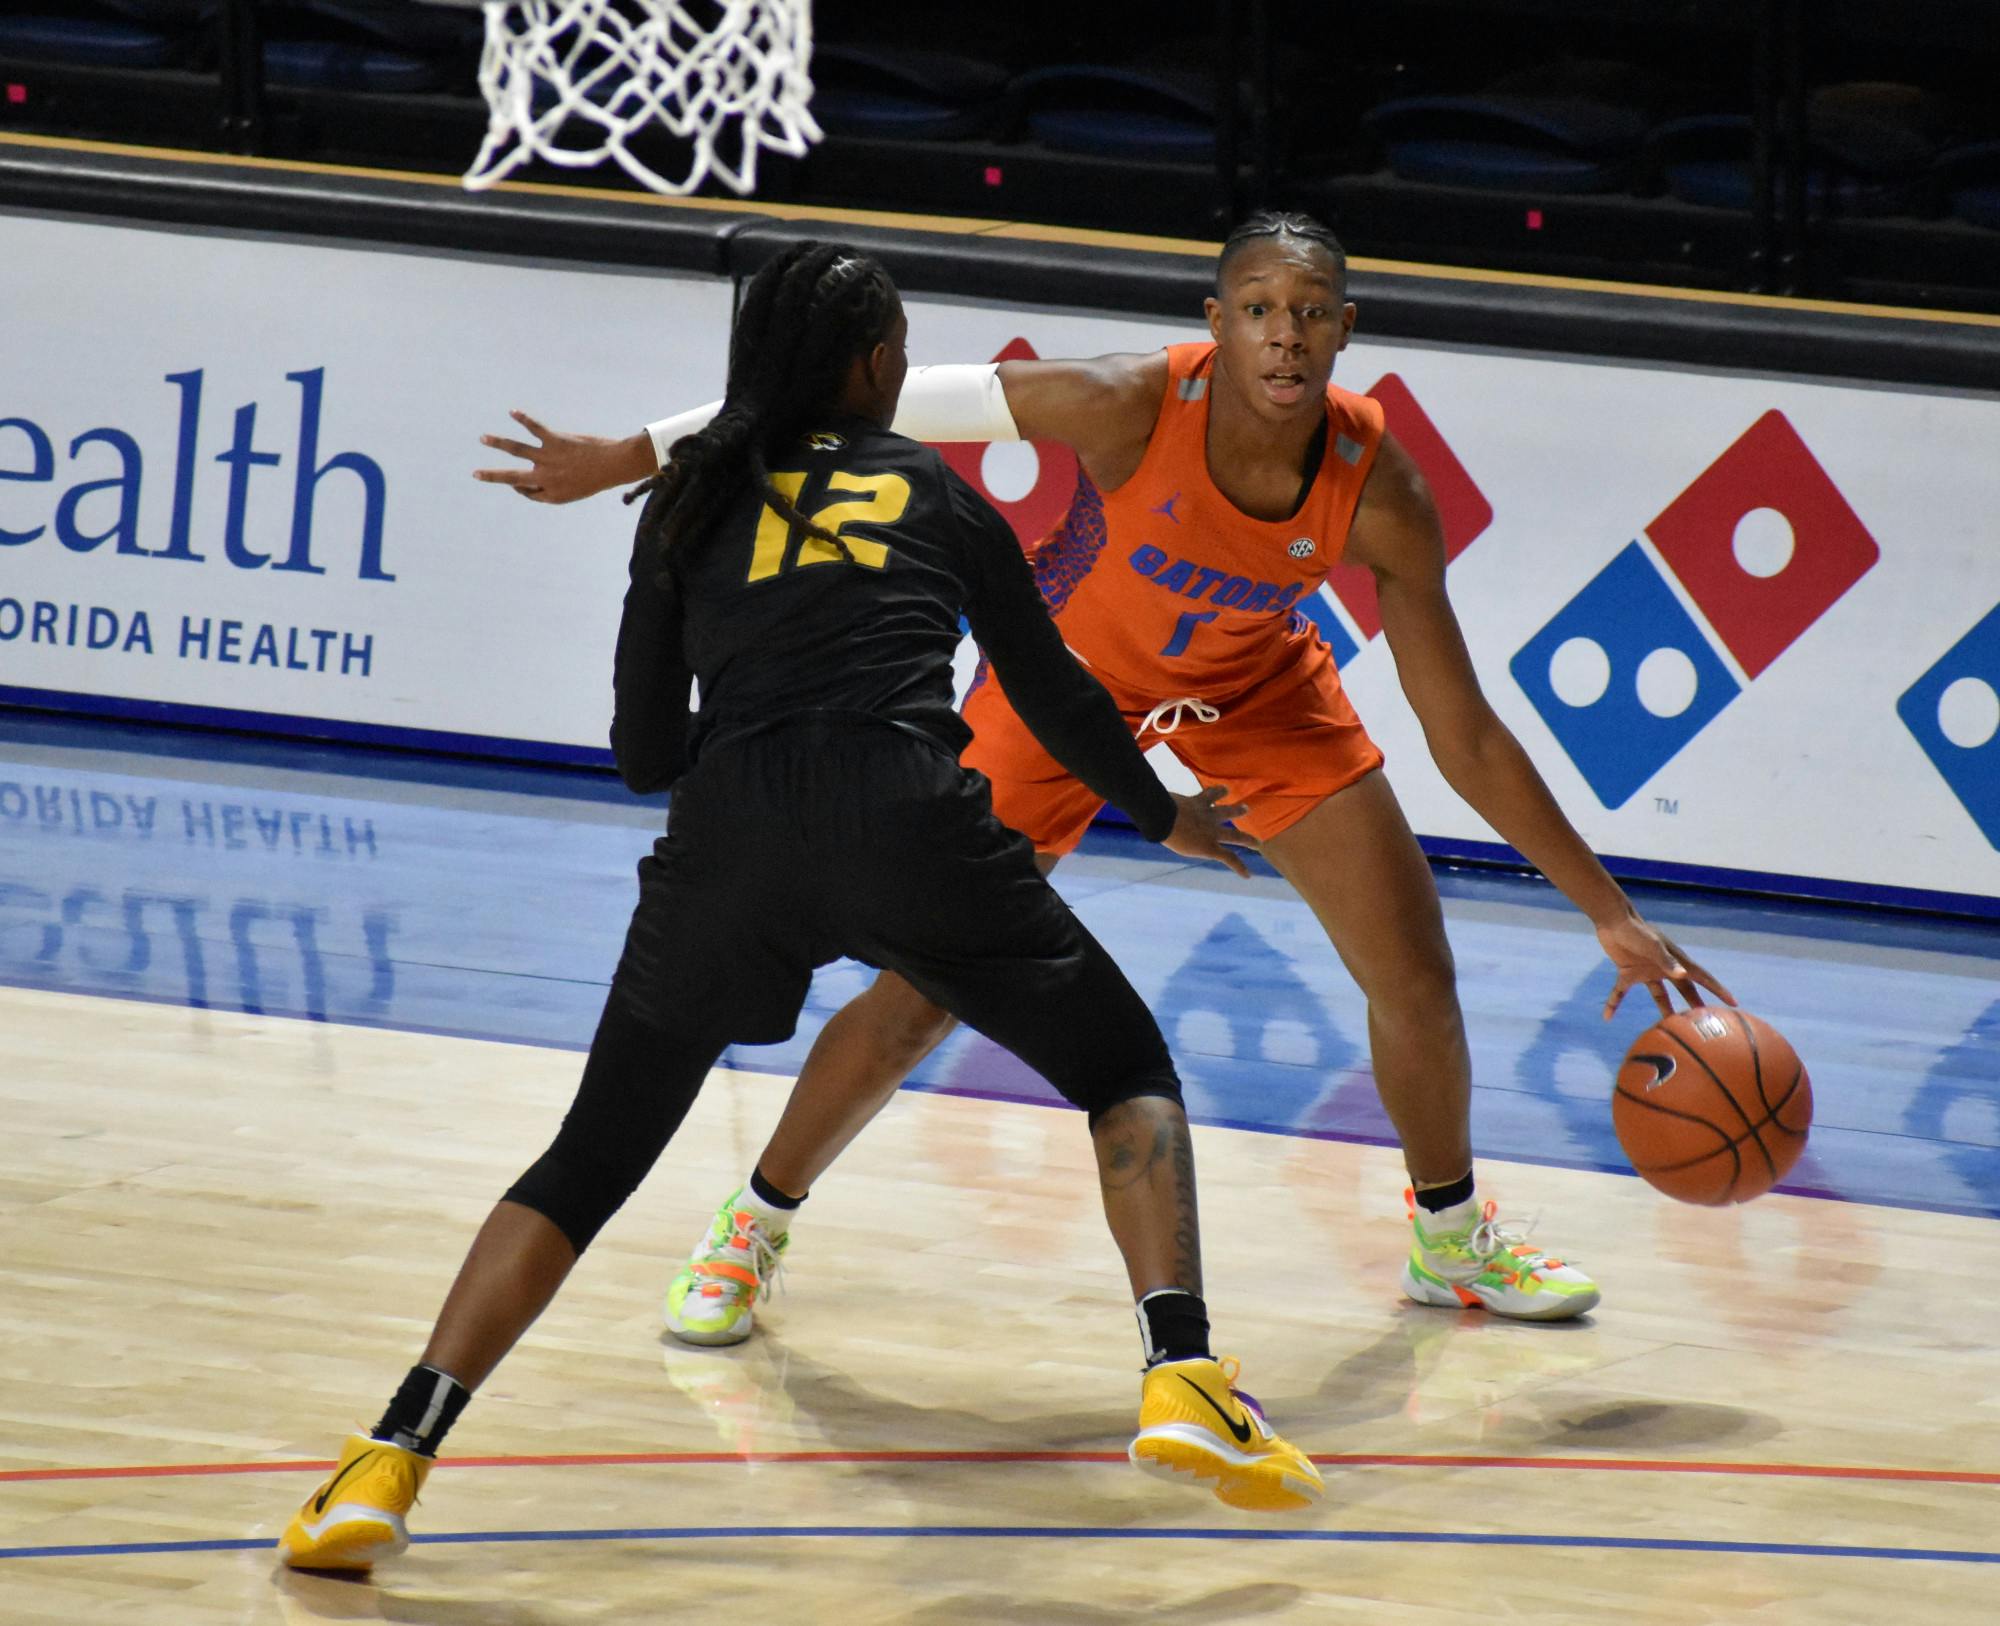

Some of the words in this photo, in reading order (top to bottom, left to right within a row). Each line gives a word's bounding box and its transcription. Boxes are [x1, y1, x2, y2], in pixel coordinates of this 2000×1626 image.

[0, 366, 396, 582] ealth
[747, 471, 911, 583] 12
[1289, 540, 1314, 558] SEC
[1129, 544, 1303, 612] GATORS
[179, 615, 375, 677] HEALTH
[1159, 611, 1220, 657] 1
[1653, 798, 1679, 815] TM
